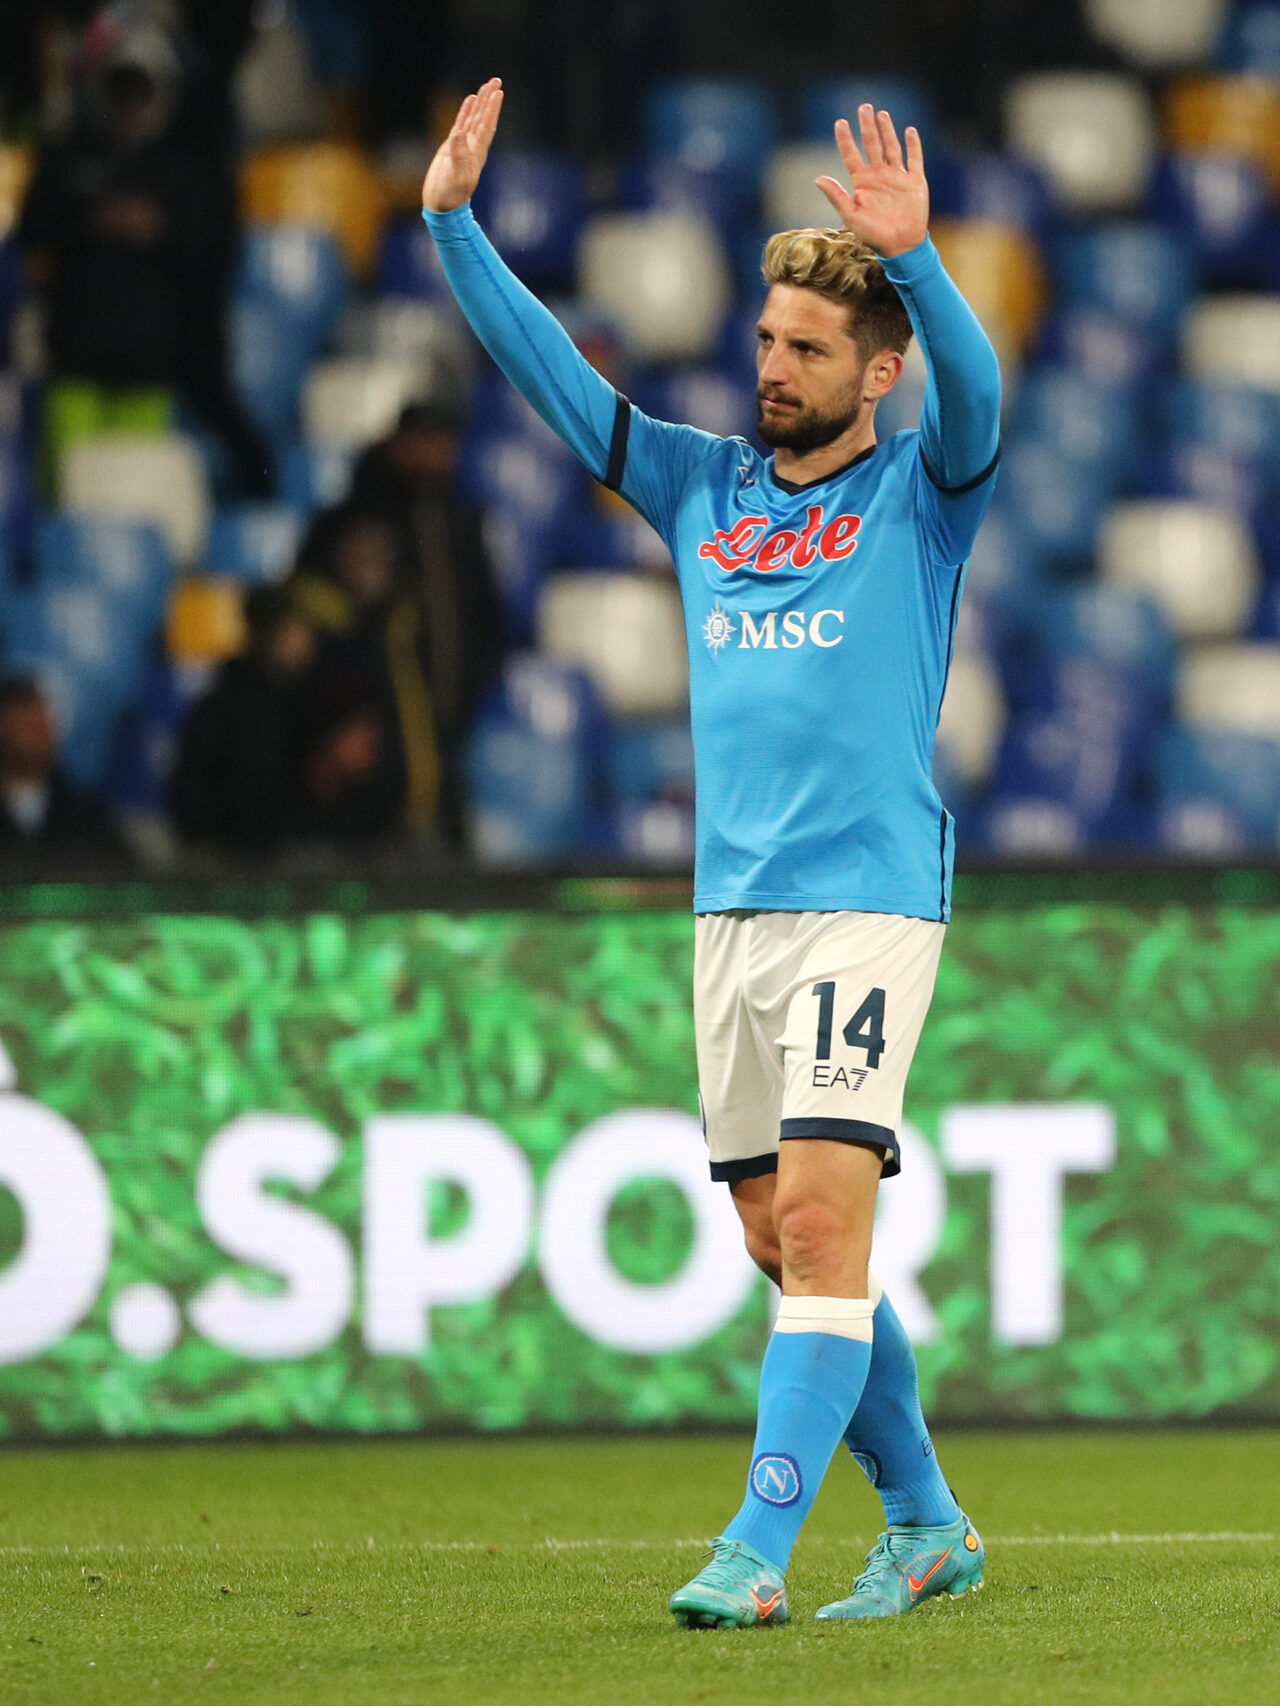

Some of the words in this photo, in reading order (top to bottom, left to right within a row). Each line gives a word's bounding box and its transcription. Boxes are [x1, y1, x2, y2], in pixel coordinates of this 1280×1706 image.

[698, 504, 862, 572] Lete
[737, 608, 845, 649] MSC
[811, 980, 887, 1070] 14
[811, 1064, 870, 1092] EA7
